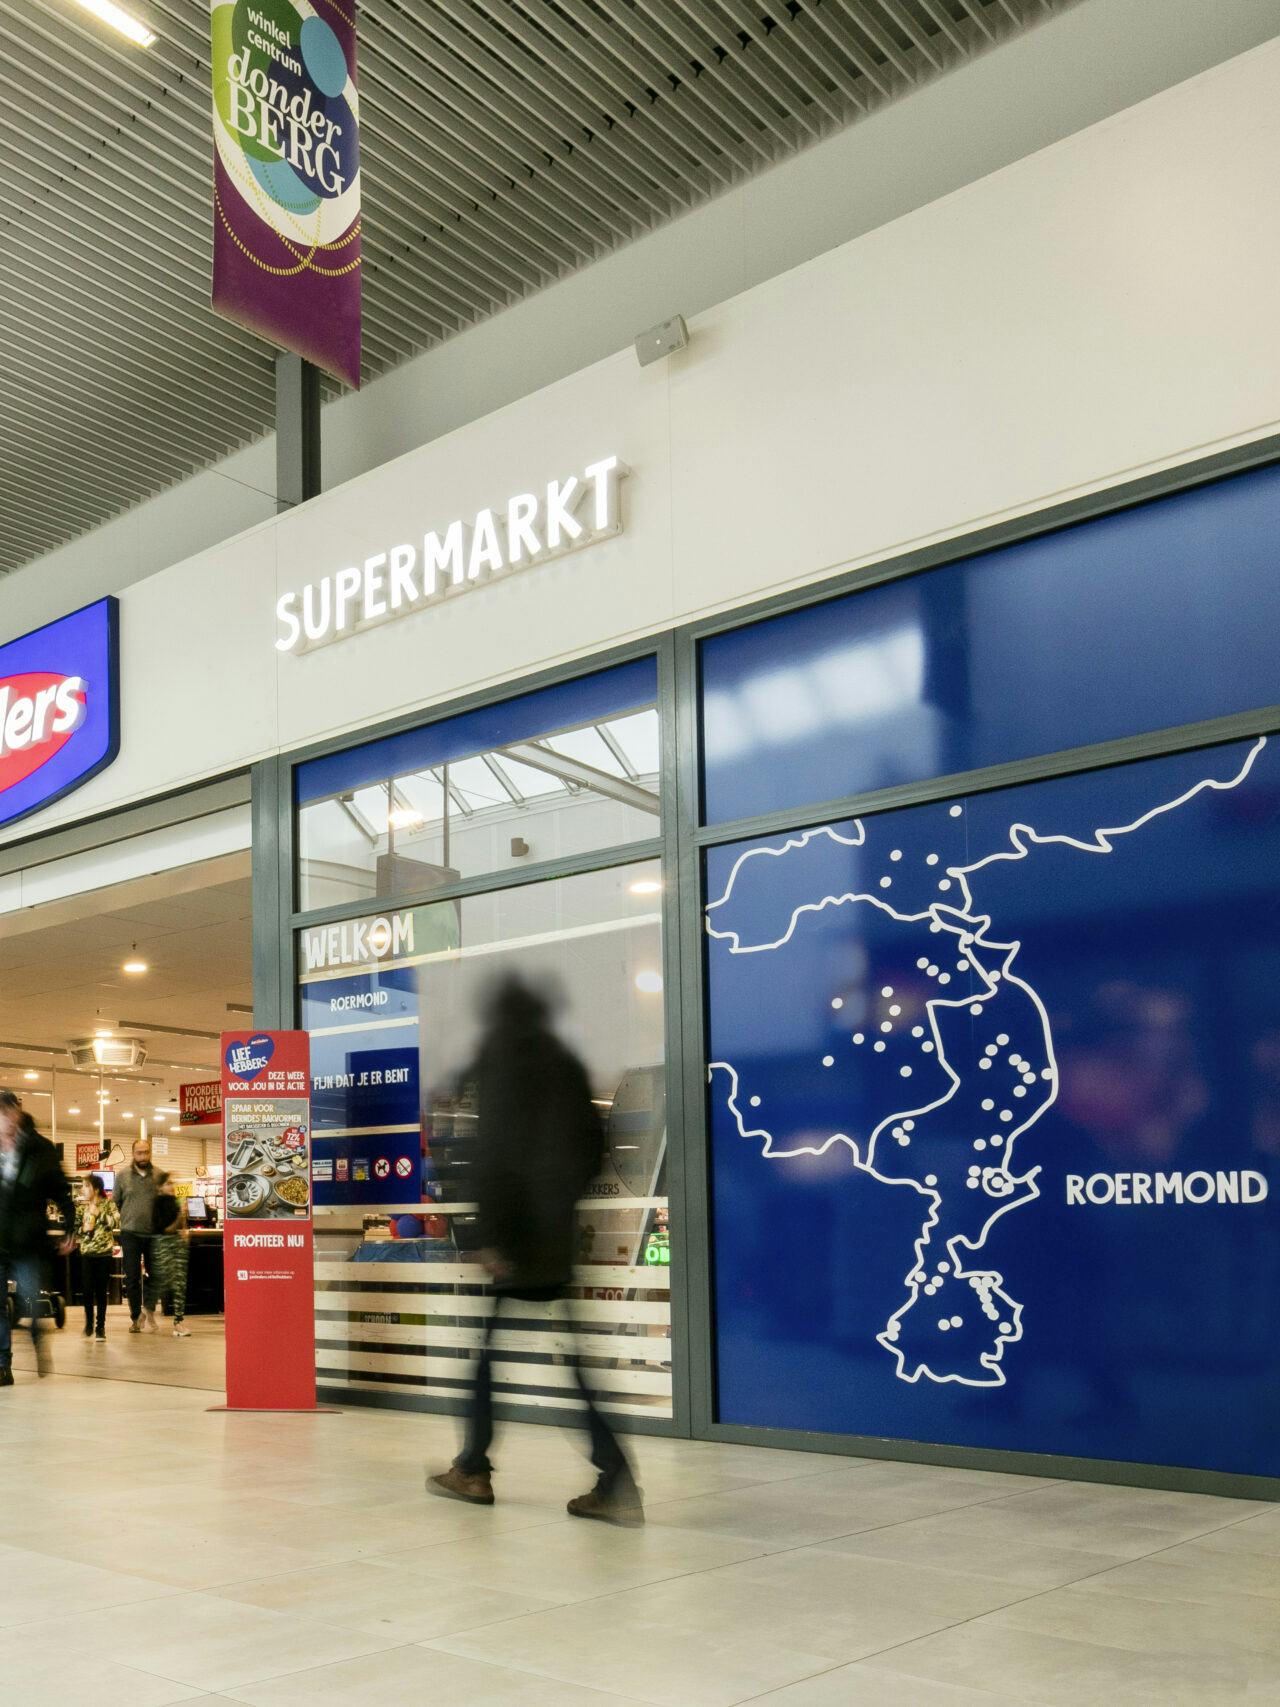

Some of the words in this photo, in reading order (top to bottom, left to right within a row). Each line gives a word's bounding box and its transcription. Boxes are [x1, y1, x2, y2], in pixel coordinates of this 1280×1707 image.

[247, 7, 291, 50] winkel
[247, 29, 302, 77] centrum
[227, 46, 342, 144] donder
[226, 76, 345, 196] BERG
[274, 455, 618, 653] SUPERMARKT
[304, 912, 415, 970] WELKOM
[330, 991, 388, 1013] ROERMOND
[229, 1056, 268, 1073] HEBBERS
[231, 1046, 251, 1062] LIEF
[228, 1082, 250, 1091] VOOR
[251, 1082, 267, 1091] JOU
[276, 1082, 285, 1091] DE
[287, 1082, 305, 1091] ACTIE
[268, 1071, 285, 1080] DEZE
[287, 1071, 305, 1080] WEEK
[313, 1076, 333, 1090] FIJN
[336, 1073, 355, 1088] DAT
[357, 1072, 369, 1086] JE
[371, 1070, 383, 1085] ER
[385, 1068, 410, 1083] BENT
[231, 1103, 252, 1113] SPAAR
[254, 1103, 274, 1113] VOOR
[1066, 1170, 1269, 1205] ROERMOND
[233, 1234, 284, 1248] PROFITEER
[287, 1234, 304, 1248] NU!
